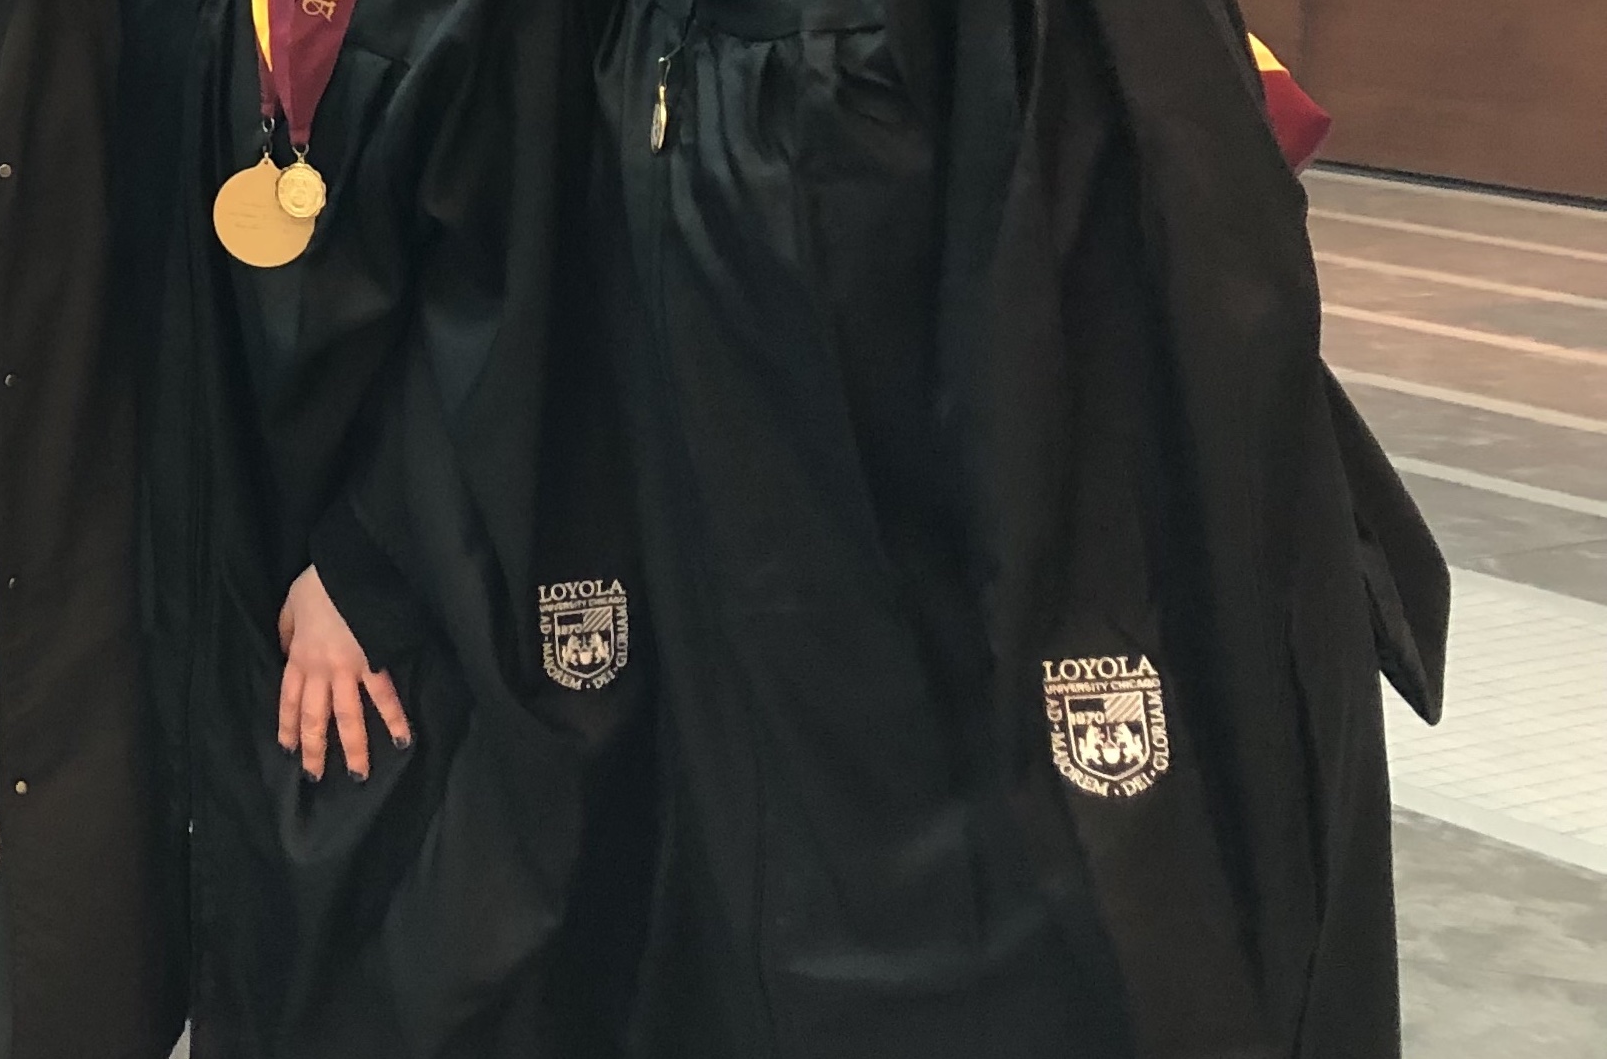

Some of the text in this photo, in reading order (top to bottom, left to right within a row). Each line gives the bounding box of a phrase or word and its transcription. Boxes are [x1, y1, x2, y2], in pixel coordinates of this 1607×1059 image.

[538, 578, 627, 603] LOYOLA
[1042, 654, 1159, 683] LOYOLA
[1043, 678, 1161, 695] UNIVERSITY CHICAGO
